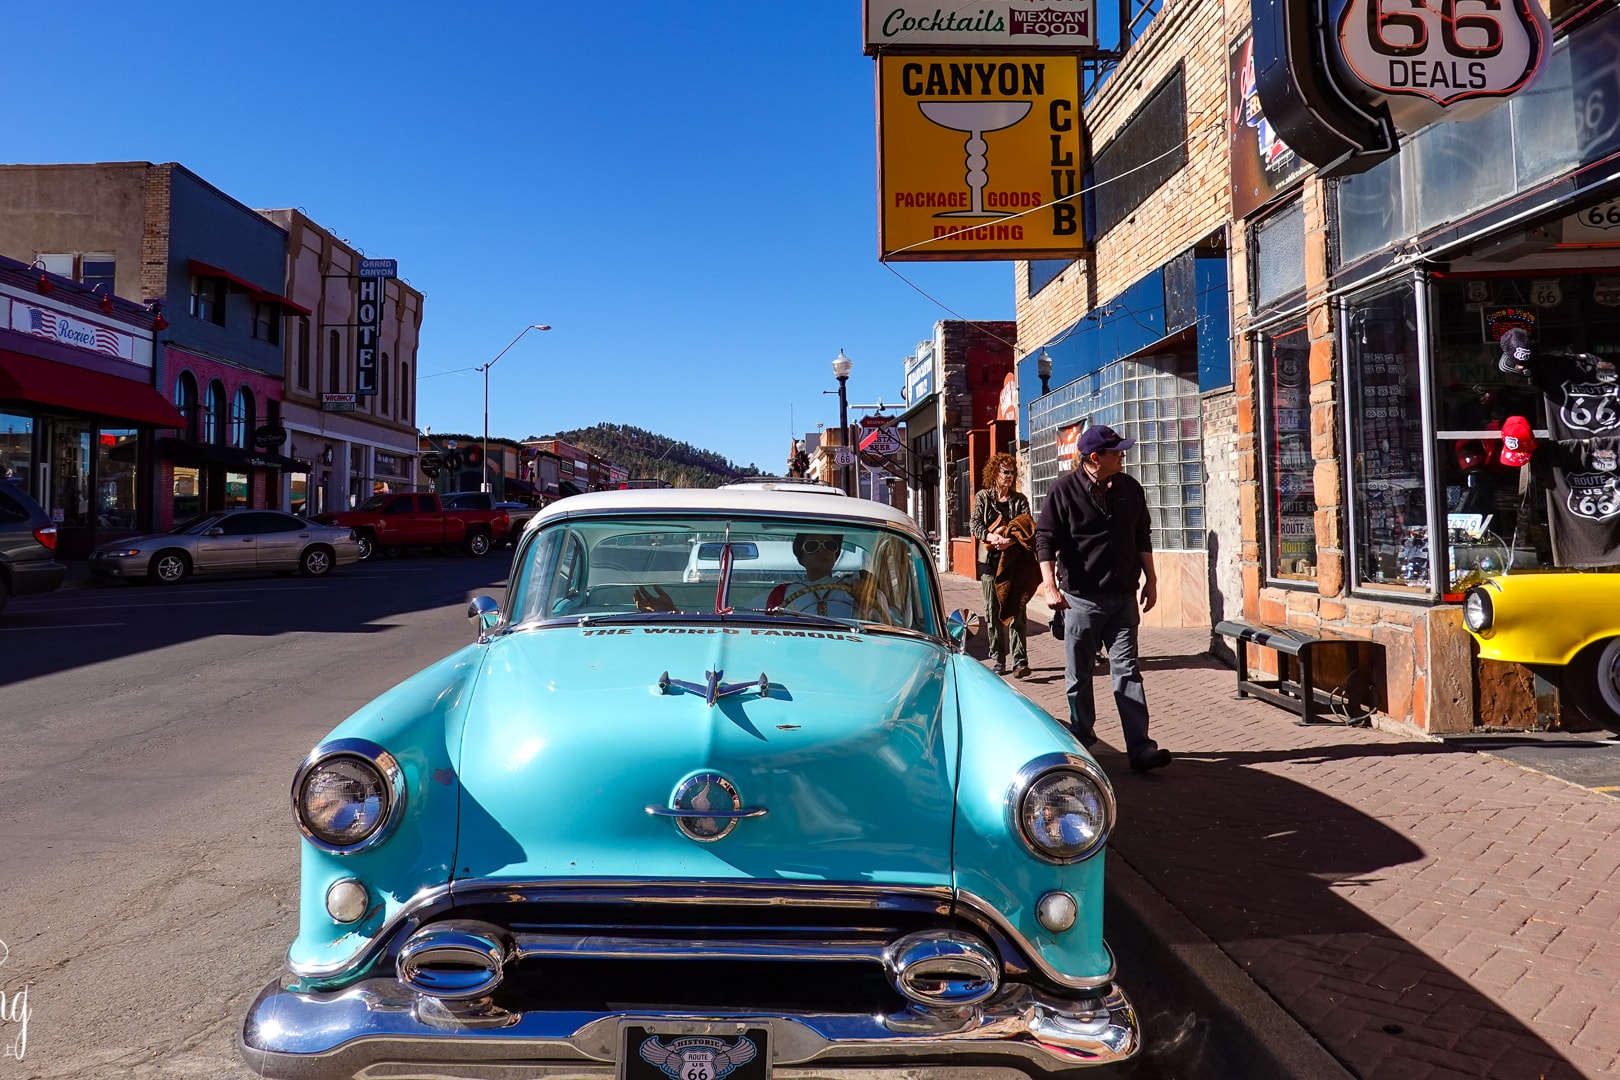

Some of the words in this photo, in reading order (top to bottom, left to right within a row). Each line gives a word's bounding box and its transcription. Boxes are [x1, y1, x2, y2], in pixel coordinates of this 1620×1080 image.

[882, 8, 1005, 37] Cocktails
[1014, 11, 1085, 23] MEXICAN
[1023, 22, 1079, 34] FOOD
[1367, 0, 1504, 58] 66
[902, 63, 1046, 96] CANYON
[1388, 59, 1487, 89] DEALS
[1050, 99, 1078, 236] CLUB
[895, 192, 968, 208] PACKAGE
[987, 191, 1042, 208] GOODS
[1588, 206, 1620, 225] 66
[933, 224, 1024, 241] DANCING
[362, 260, 392, 268] GRAND
[360, 268, 394, 276] CANYON
[1537, 290, 1556, 304] 66
[58, 319, 96, 346] Roxie's
[359, 281, 376, 390] HOTEL
[325, 394, 353, 402] VACANCY
[1570, 397, 1617, 425] 66
[840, 455, 851, 464] 66
[1573, 475, 1607, 486] ROUTE
[1579, 495, 1614, 515] 66
[1280, 523, 1305, 534] ROUTE
[1281, 541, 1306, 553] ROUTE
[583, 628, 634, 637] THE
[642, 627, 740, 636] WORLD
[750, 628, 864, 643] FAMOUS
[677, 1038, 720, 1048] HISTORIC
[688, 1053, 708, 1061] ROUTE
[687, 1068, 708, 1080] 66
